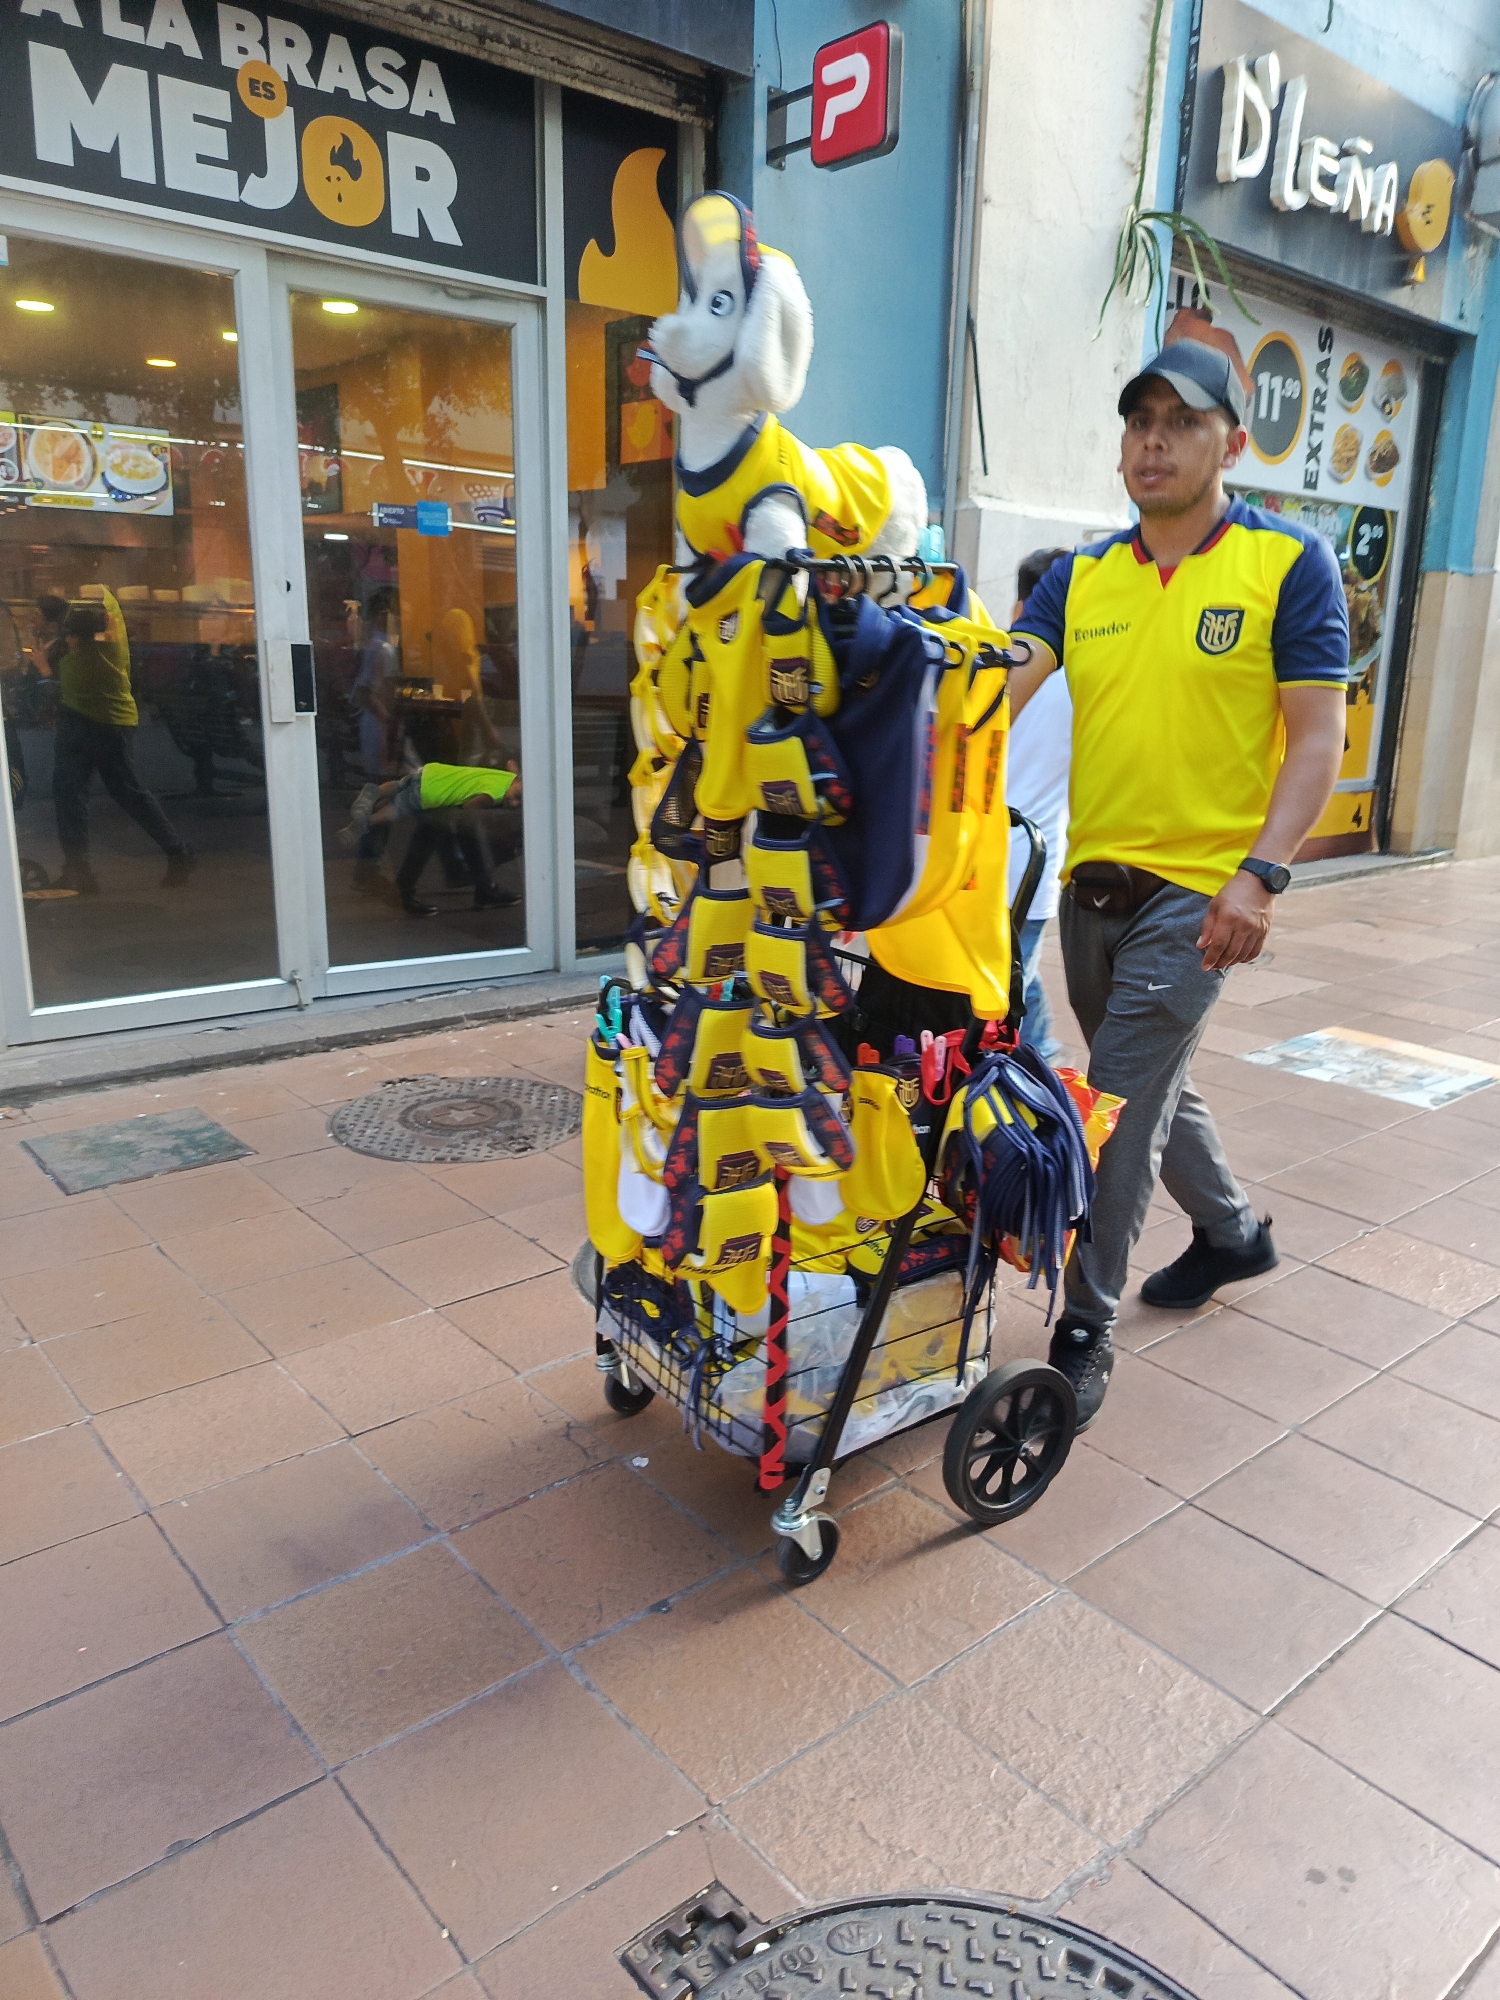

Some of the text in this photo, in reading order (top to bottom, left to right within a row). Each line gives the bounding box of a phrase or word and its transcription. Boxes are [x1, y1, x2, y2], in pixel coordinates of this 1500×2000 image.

[217, 2, 456, 125] BRASA
[247, 76, 276, 102] ES
[820, 52, 871, 141] P
[27, 41, 463, 246] MEJOR
[1257, 371, 1301, 422] 11.99
[1302, 325, 1335, 491] EXTRAS
[1073, 620, 1132, 643] Ecuador
